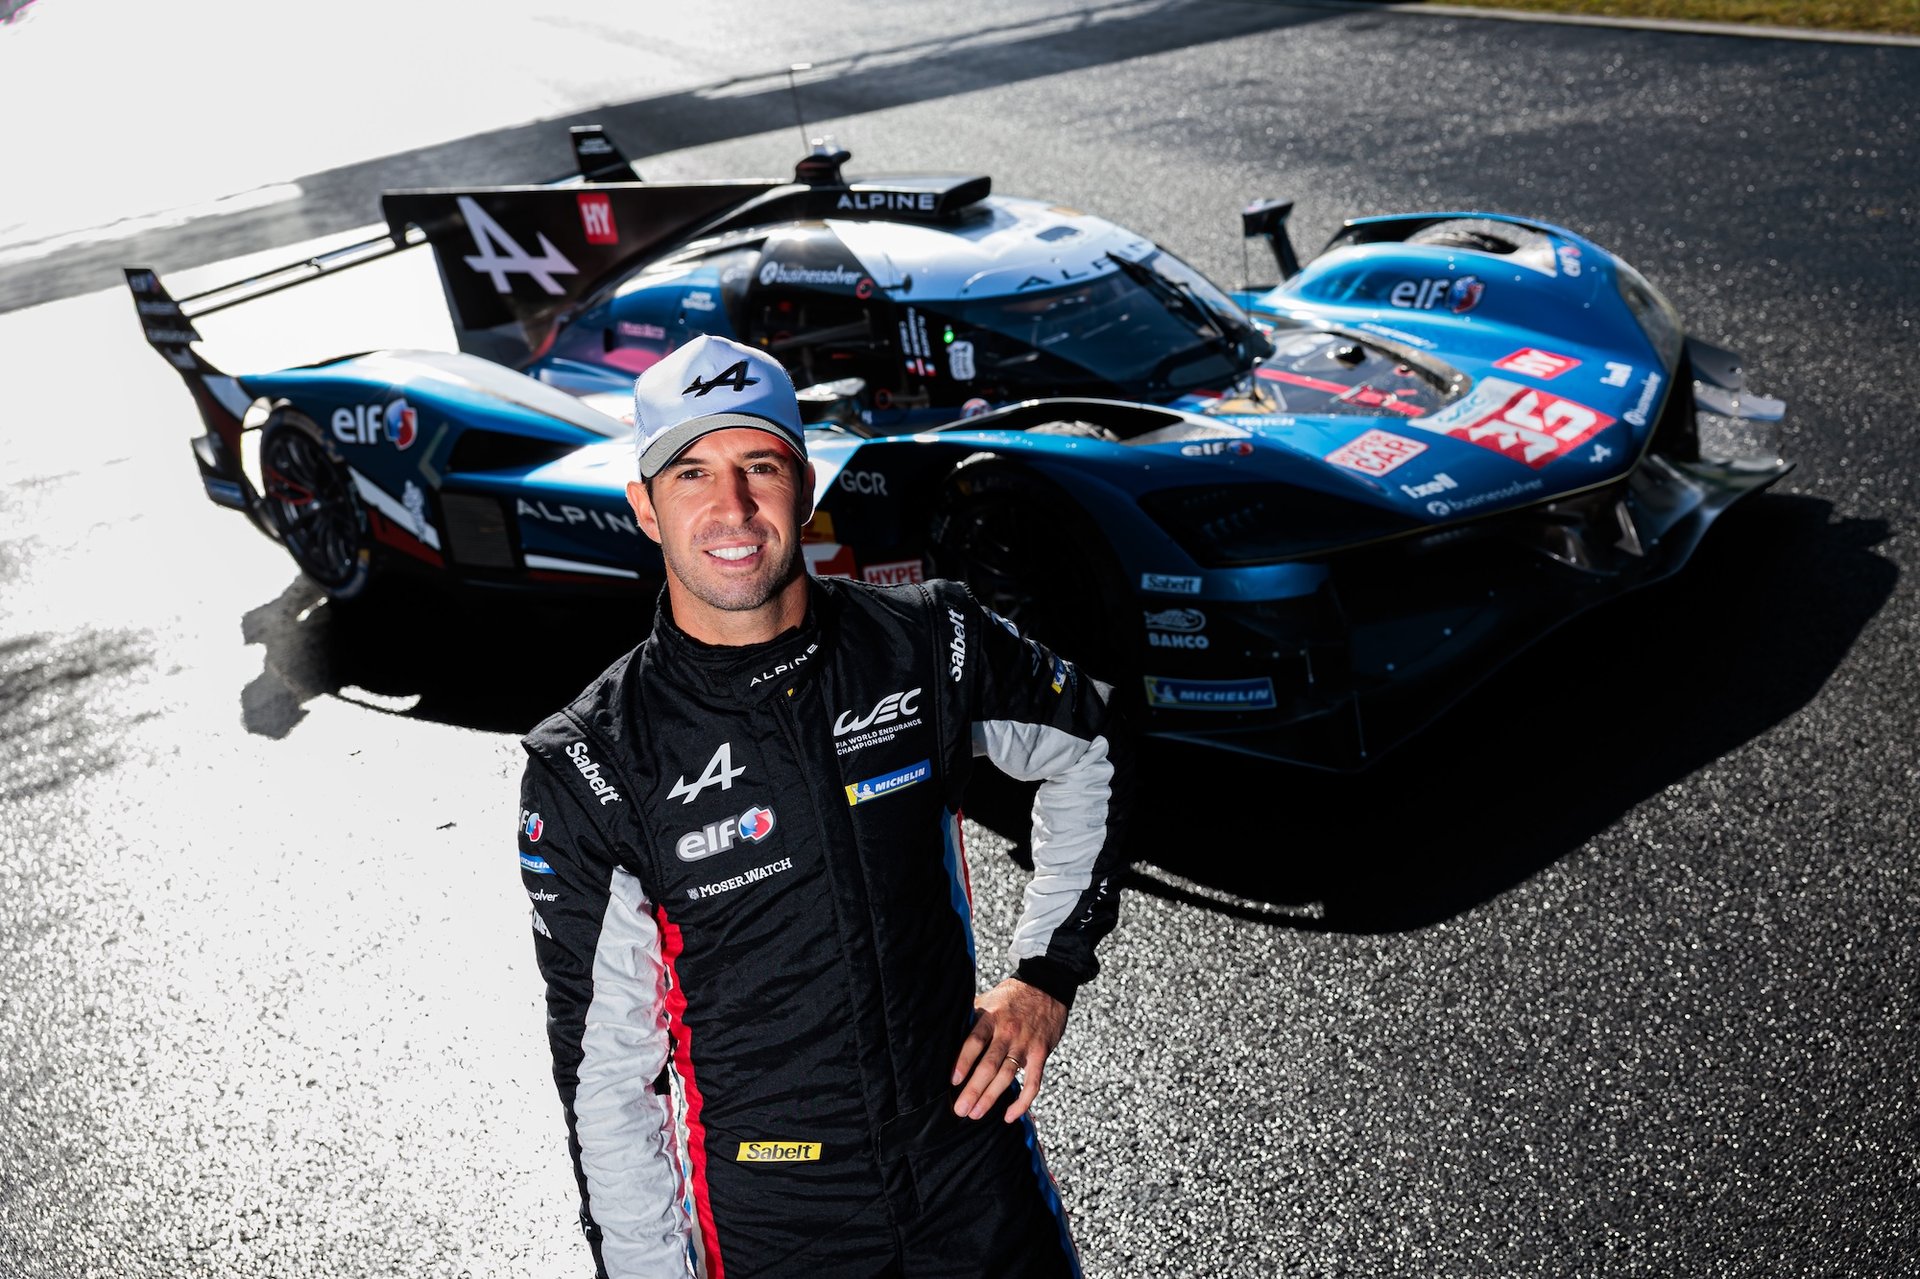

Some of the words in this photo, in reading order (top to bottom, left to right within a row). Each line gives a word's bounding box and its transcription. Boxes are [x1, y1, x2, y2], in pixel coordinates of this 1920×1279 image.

[837, 193, 935, 210] ALPINE
[581, 203, 611, 235] HY
[1390, 278, 1449, 309] elf
[1503, 349, 1566, 378] HY
[332, 405, 383, 444] elf
[1468, 390, 1597, 464] 35
[1181, 442, 1225, 457] elf
[1355, 438, 1416, 473] CAR
[839, 469, 889, 497] GCR
[517, 498, 639, 536] ALPIN
[947, 609, 966, 682] Sabelt
[749, 643, 818, 687] ALPINE
[1179, 688, 1269, 702] MICHELIN
[833, 687, 922, 737] WEC
[835, 741, 848, 749] FIA
[848, 731, 878, 745] WORLD
[878, 718, 922, 736] ENDURANCE
[836, 733, 896, 756] CHAMPIONSHIP
[565, 741, 622, 805] Sabelt
[875, 767, 925, 792] MICHELIN
[679, 817, 737, 860] elf
[699, 857, 793, 898] MOSER.WATCH
[746, 1143, 815, 1160] Sabelt
